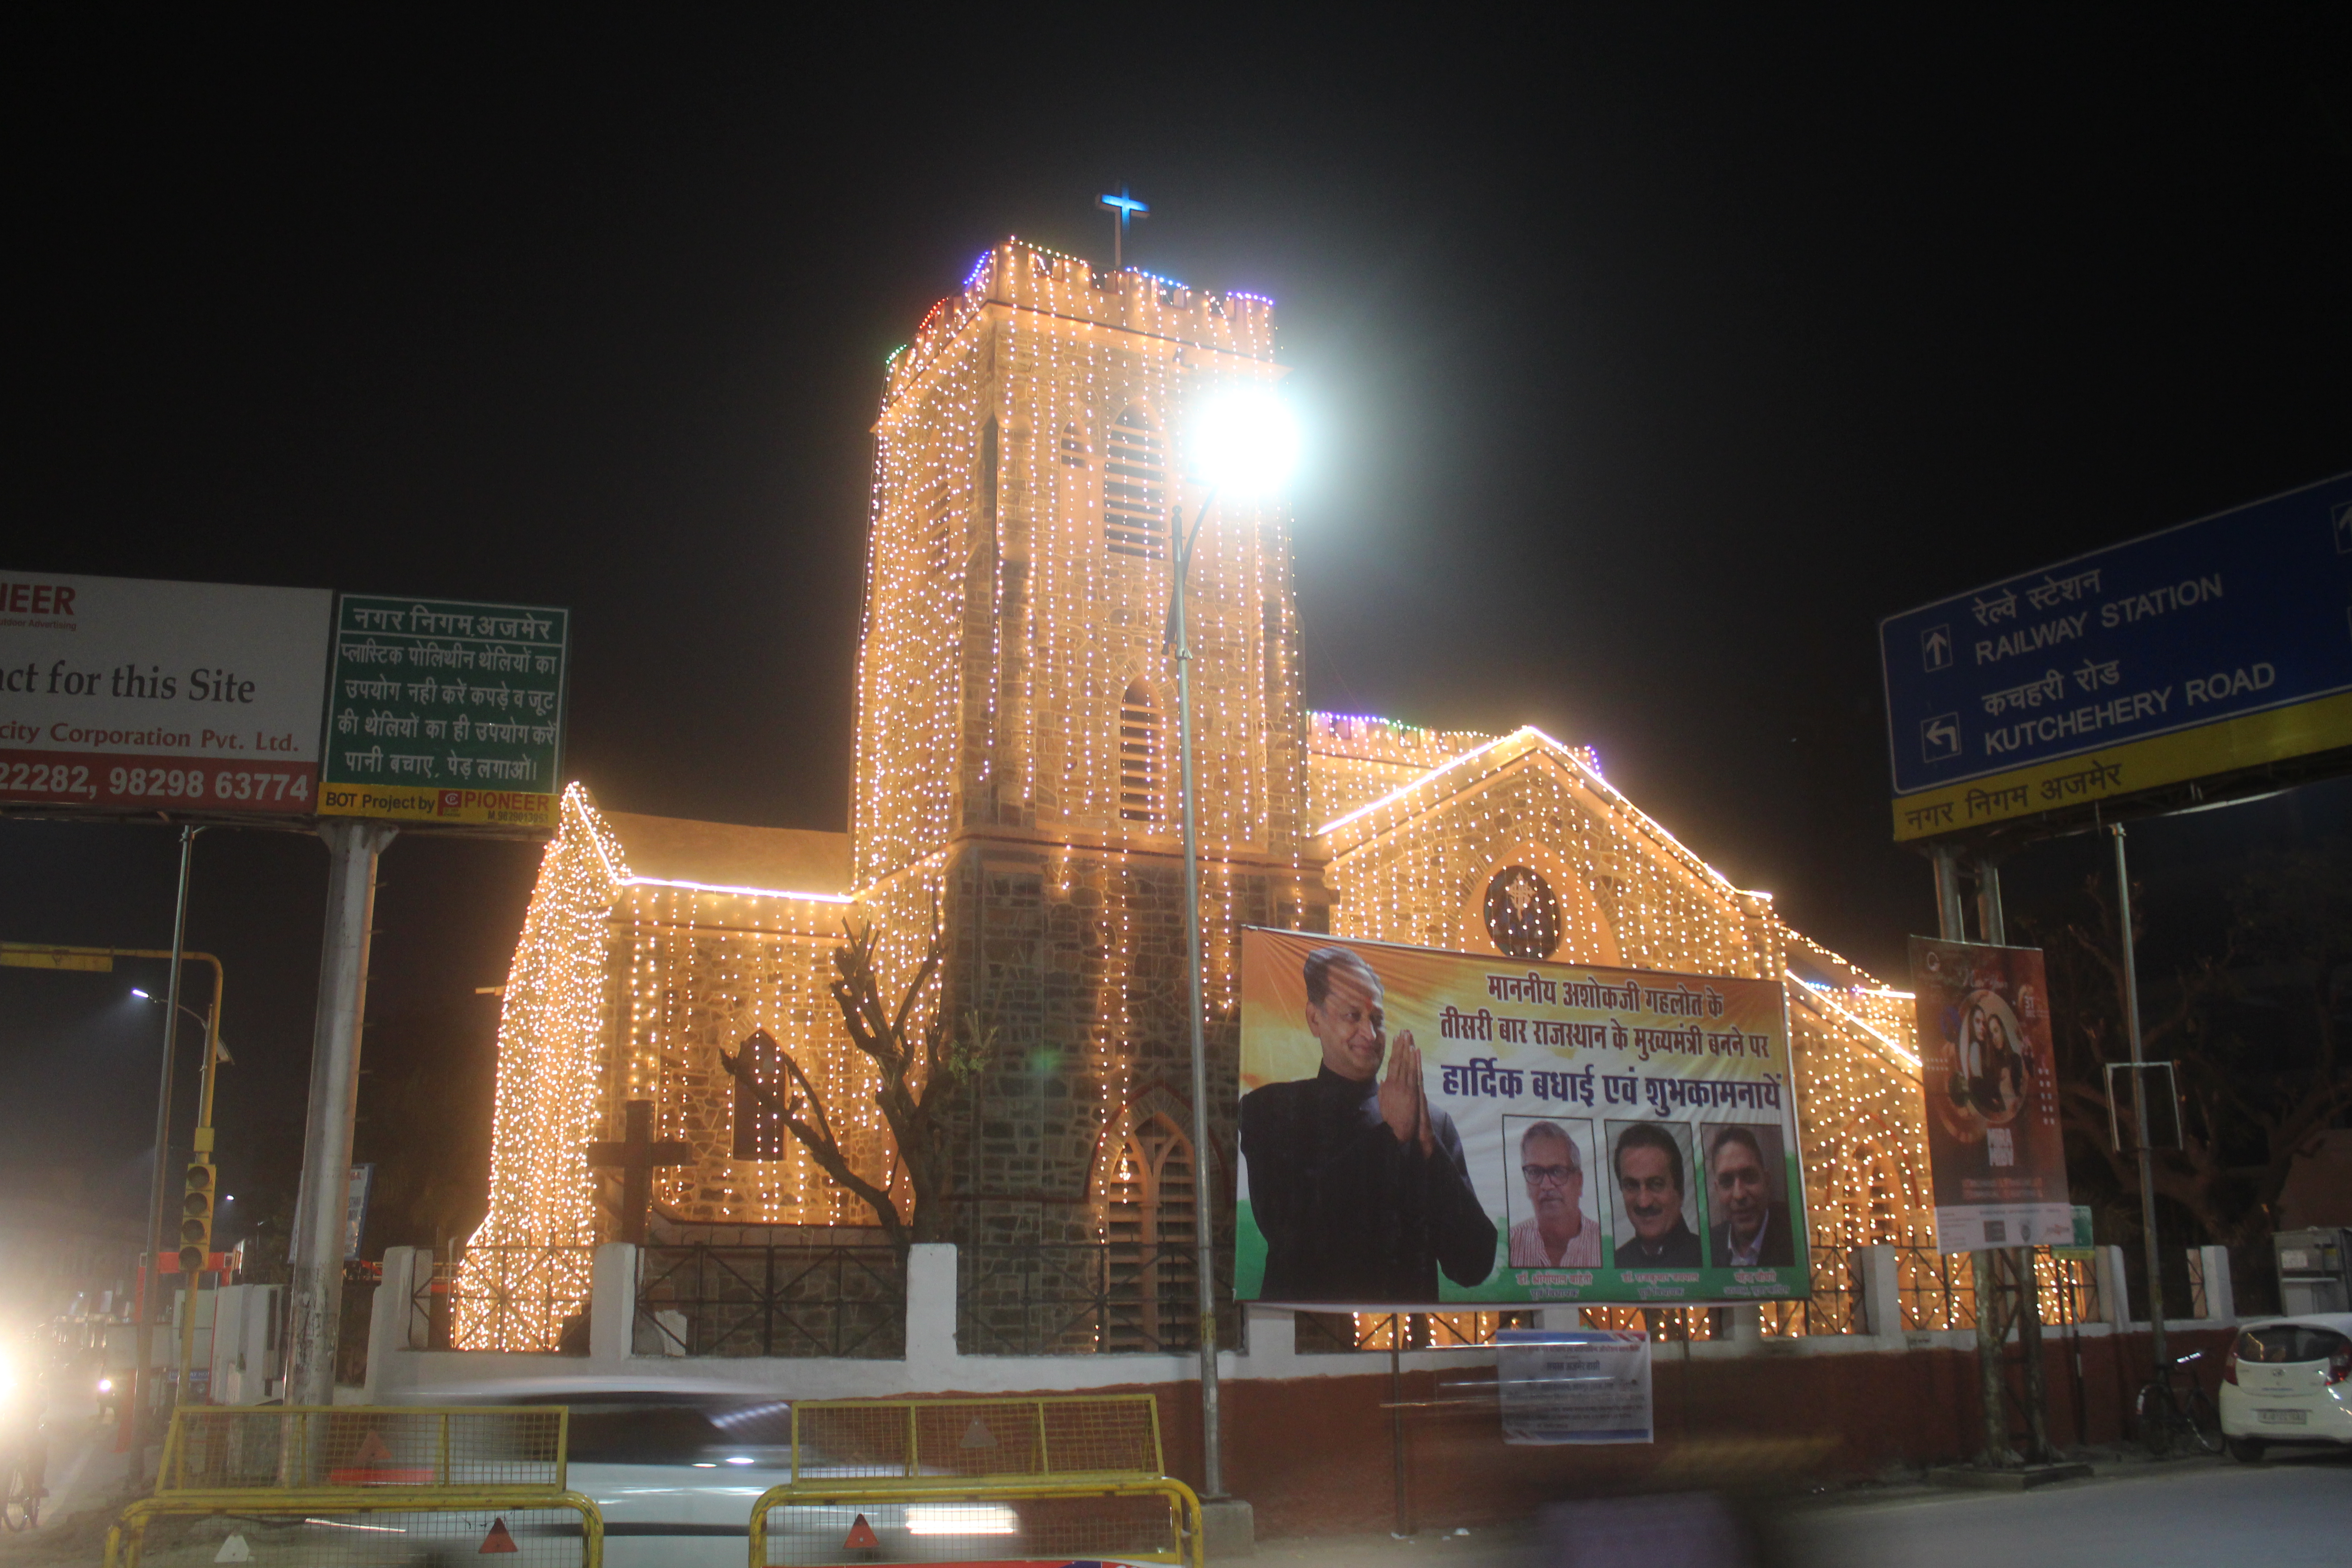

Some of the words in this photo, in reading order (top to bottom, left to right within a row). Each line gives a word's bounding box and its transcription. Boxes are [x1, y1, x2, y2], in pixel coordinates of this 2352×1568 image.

[2026, 568, 2102, 610] स्टेशन
[29, 618, 77, 632] Advertising
[353, 608, 405, 631] नगर
[476, 612, 552, 640] अजमेर
[1975, 612, 2088, 665] RAILWAY
[2101, 573, 2223, 628] STATION
[341, 637, 404, 664] प्लास्टिक
[408, 640, 475, 669] पोलिथीन
[534, 655, 557, 675] का
[47, 660, 102, 696] for
[112, 664, 176, 700] this
[189, 668, 255, 703] Site
[345, 673, 401, 701] उपयोग
[470, 681, 510, 711] कपड़े
[513, 689, 527, 708] व
[528, 690, 555, 716] जूट
[1982, 669, 2064, 716] कचहरी
[2073, 658, 2120, 692] रोड
[338, 708, 359, 735] की
[425, 720, 447, 739] का
[453, 714, 470, 742] ही
[475, 717, 529, 744] उपयोग
[1984, 686, 2173, 756] KUTCHEHERY
[2186, 662, 2276, 706] ROAD
[50, 723, 191, 747] Corporation
[201, 729, 244, 750] Pvt.
[255, 732, 299, 752] Ltd.
[345, 745, 383, 772] पानी
[447, 749, 473, 780] पेड़
[110, 767, 204, 799] 98298
[215, 771, 308, 802] 63774
[326, 792, 358, 808] BOT
[362, 794, 415, 813] Project
[418, 796, 436, 813] by
[464, 791, 550, 811] PIONEER
[1906, 801, 1954, 831] नगर
[1965, 788, 2029, 819] निगम
[2040, 759, 2123, 801] अजमेर
[1487, 972, 1557, 1004] माननीय
[1562, 976, 1641, 1013] अशोकजी
[1645, 985, 1704, 1014] गहलोत
[1707, 985, 1724, 1019] के
[1440, 1005, 1494, 1043] तीसरी
[1498, 1017, 1528, 1044] बार
[1533, 1019, 1607, 1050] राजस्थान
[1611, 1018, 1628, 1051] के
[1633, 1022, 1704, 1062] मुख्यमंत्री
[1707, 1027, 1745, 1058] बनने
[1748, 1034, 1770, 1059] पर
[1441, 1058, 1524, 1099] हार्दिक
[1530, 1064, 1595, 1107] बधाई
[1602, 1066, 1640, 1105] एवं
[1645, 1072, 1783, 1117] शुभकामनायें
